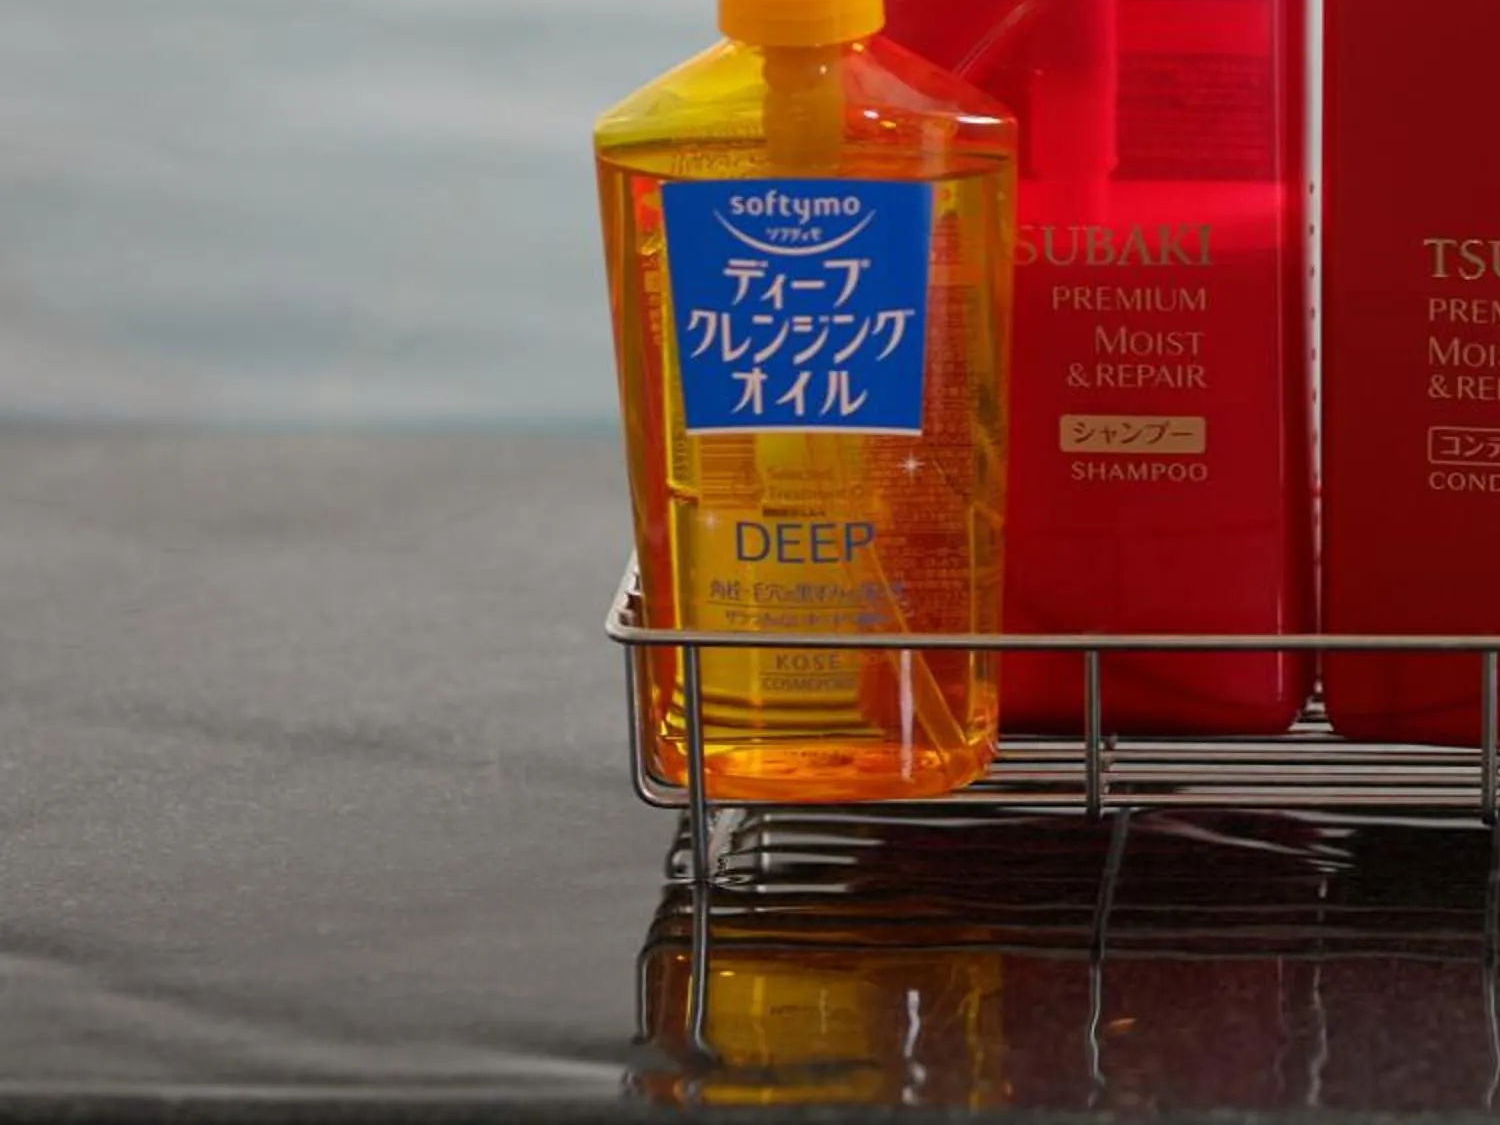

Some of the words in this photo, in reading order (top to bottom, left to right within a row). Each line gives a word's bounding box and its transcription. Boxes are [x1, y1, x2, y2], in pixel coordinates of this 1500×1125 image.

[729, 189, 860, 225] softymo
[1013, 224, 1214, 266] SUBAKI
[723, 259, 871, 311] ディープ
[1051, 285, 1207, 312] PREMIUM
[687, 309, 915, 365] クレンジング
[730, 368, 868, 416] オイル
[1071, 420, 1195, 445] シャンプー
[1071, 460, 1208, 482] SHAMPOO
[735, 521, 875, 564] DEEP
